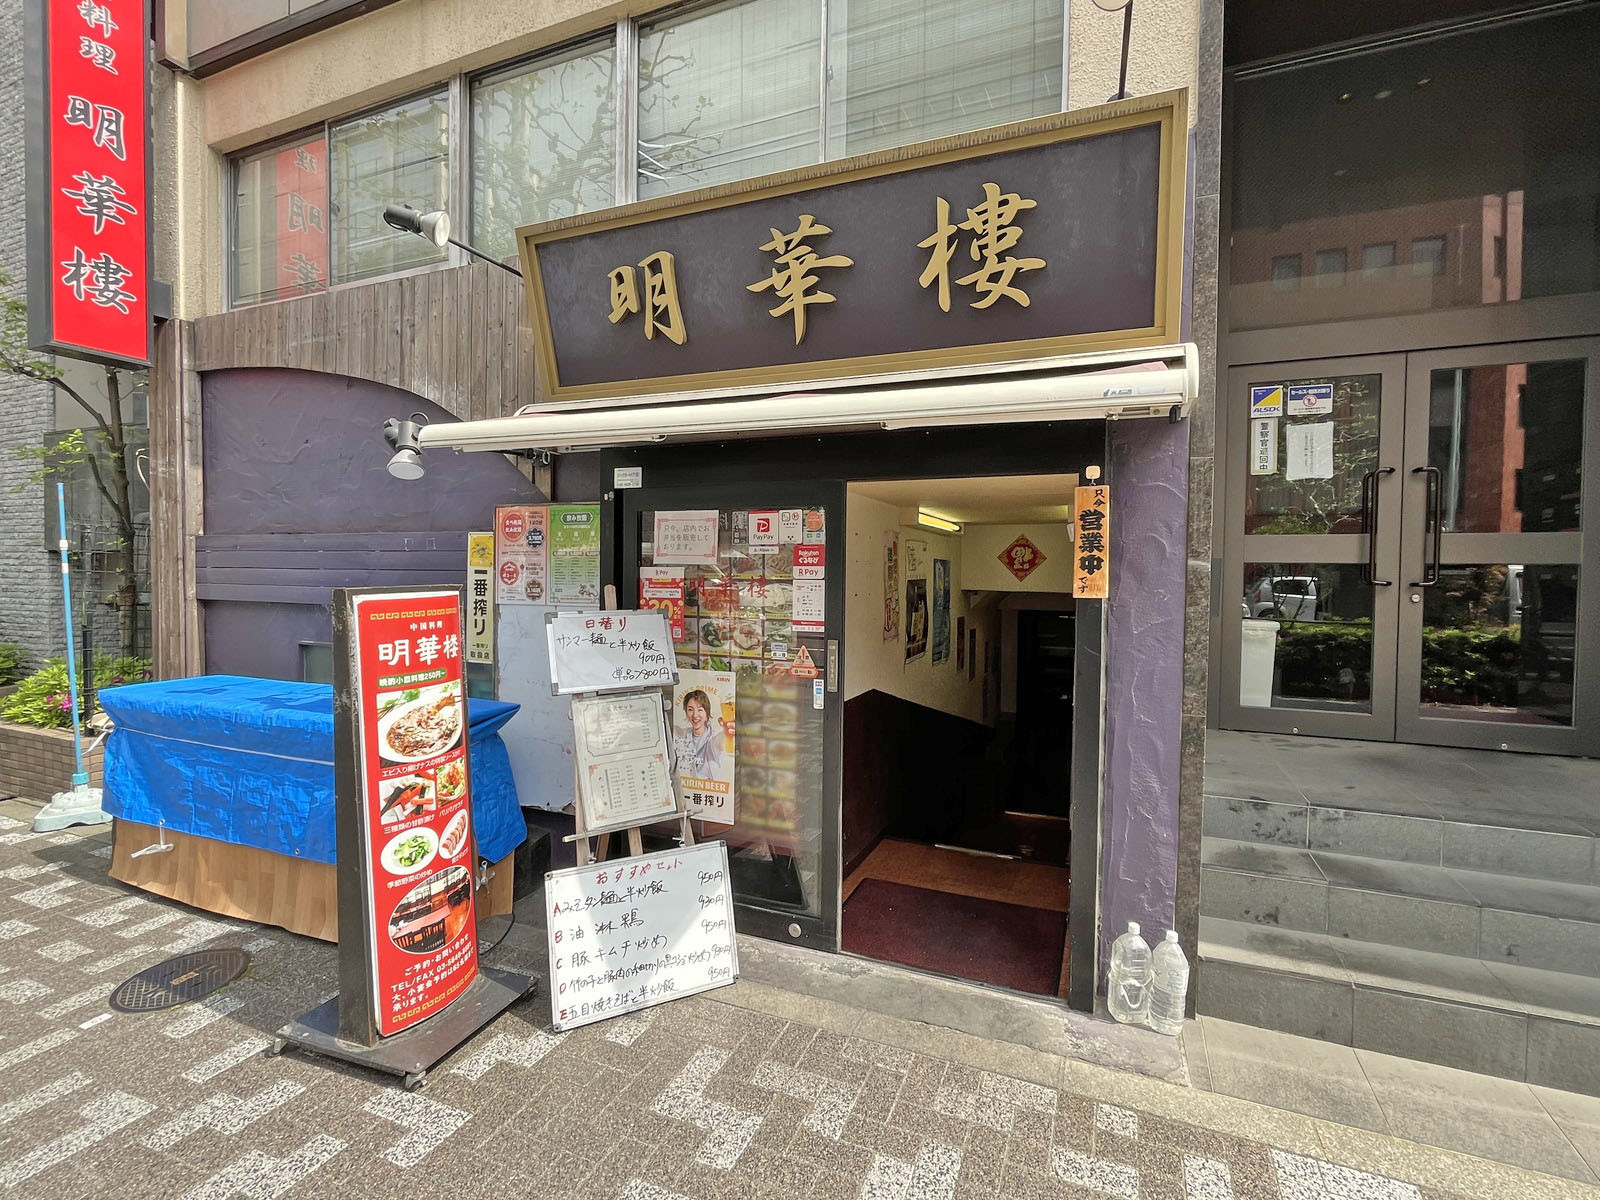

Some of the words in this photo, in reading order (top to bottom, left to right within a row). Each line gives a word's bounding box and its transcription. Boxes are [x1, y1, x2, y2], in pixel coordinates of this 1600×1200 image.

[606, 181, 1047, 346] 明華樓
[1093, 488, 1106, 508] 只今
[1079, 508, 1106, 576] 営業中
[1078, 576, 1088, 593] です
[473, 569, 488, 636] 一番搾り
[585, 616, 628, 633] 日替り
[638, 652, 666, 665] 900円
[680, 778, 705, 789] KIRIN
[704, 781, 727, 792] BEER
[683, 793, 725, 808] 一番搾り
[554, 930, 563, 943] B
[555, 958, 563, 970] C
[559, 1009, 568, 1021] E
